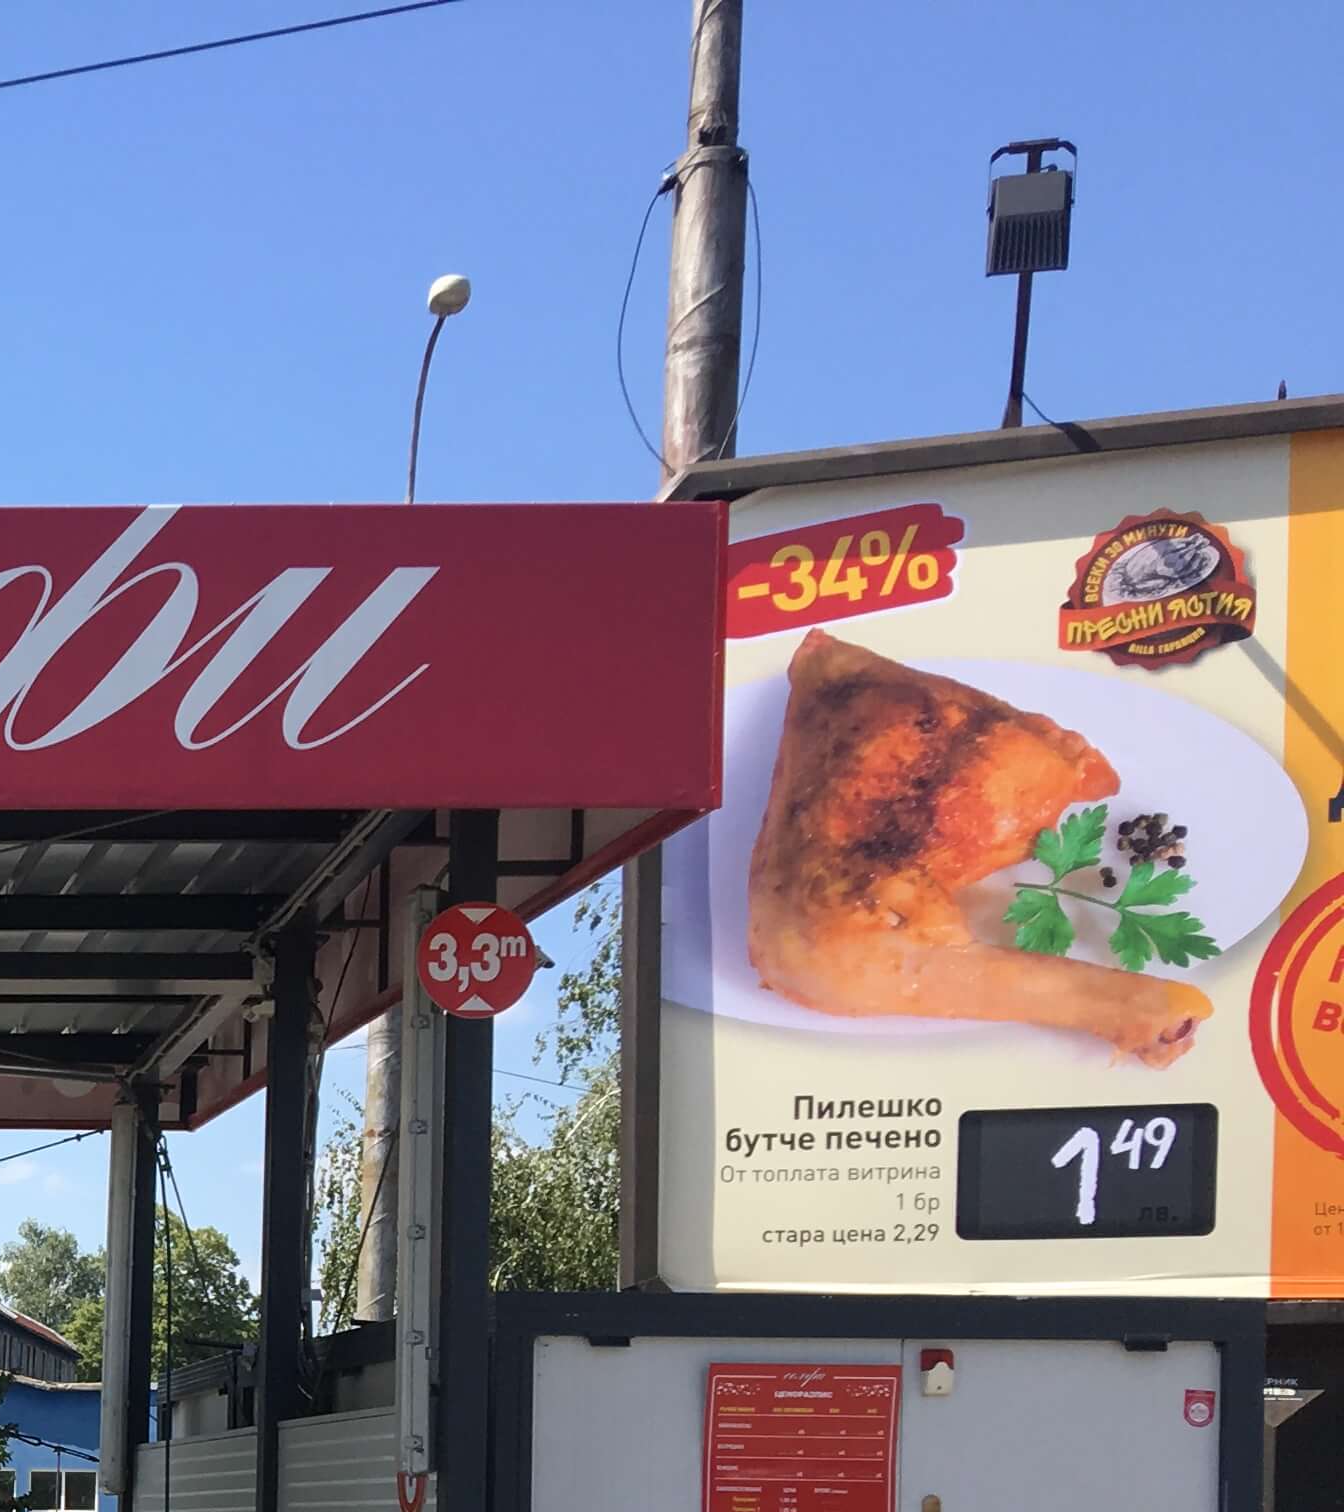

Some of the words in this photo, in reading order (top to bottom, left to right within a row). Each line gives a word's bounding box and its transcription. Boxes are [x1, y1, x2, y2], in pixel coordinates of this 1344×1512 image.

[1123, 523, 1190, 547] МИНУТИ
[738, 523, 939, 612] -34%
[1066, 604, 1165, 645] ПРЕСНИ
[1166, 591, 1253, 621] ЯСТИЯ
[794, 1095, 943, 1120] Пилешко
[725, 1128, 816, 1158] бутче
[825, 1128, 942, 1150] печено
[720, 1165, 747, 1183] От
[752, 1167, 840, 1183] топлата
[847, 1165, 941, 1185] витрина
[913, 1192, 940, 1215] бр
[762, 1229, 825, 1247] стара
[832, 1228, 887, 1245] цена
[893, 1223, 940, 1244] 2,29
